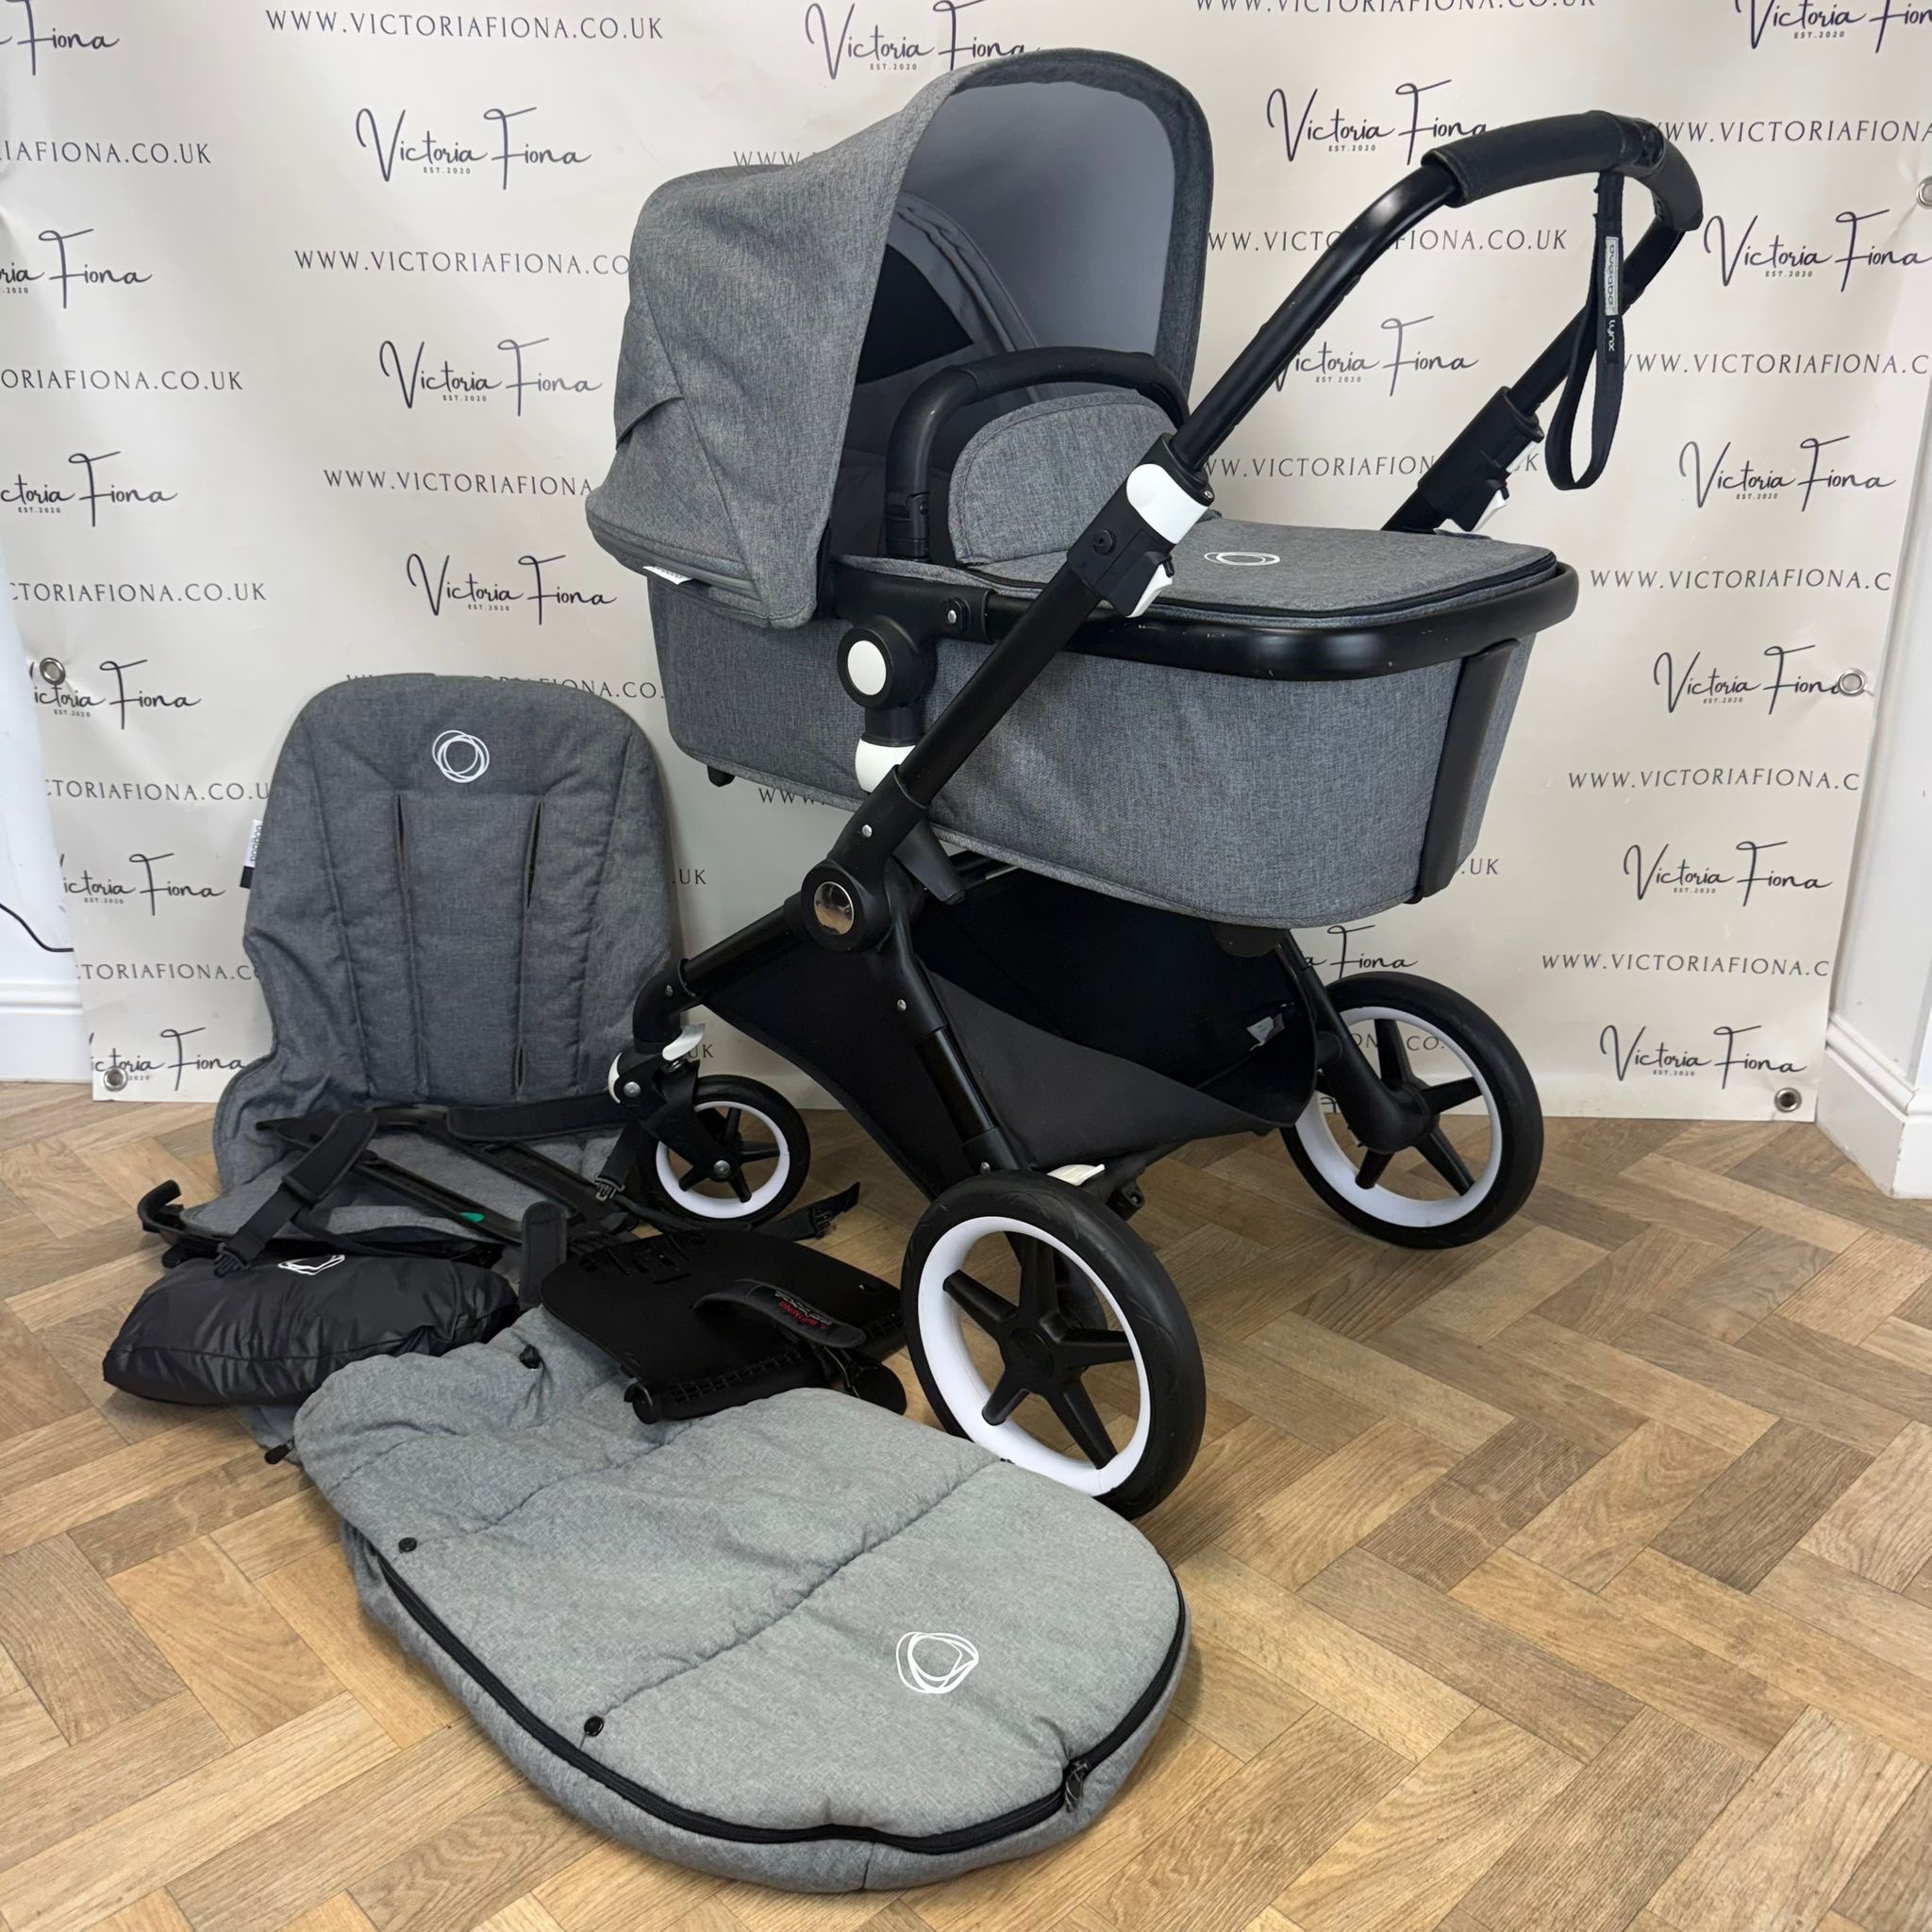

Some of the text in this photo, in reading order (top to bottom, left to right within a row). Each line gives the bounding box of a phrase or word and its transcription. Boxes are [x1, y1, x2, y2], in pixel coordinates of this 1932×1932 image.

[265, 9, 664, 41] WWW.VICTORIAFIONA.CO.UK
[806, 3, 936, 79] Victoria
[0, 141, 211, 164] IAFIONA.CO.UK
[356, 106, 593, 191] Victoria Fiona
[1266, 88, 1396, 163] Victoria
[1328, 144, 1377, 153] EST.2020
[423, 166, 472, 175] EST.2020
[0, 228, 153, 309] ria Fiona
[1703, 208, 1932, 292] Victoria Fiona
[1765, 270, 1814, 278] EST.2020
[378, 337, 604, 417] Victoria Fiona
[1380, 314, 1480, 397] Fiona
[442, 394, 489, 403] EST.2020
[67, 450, 178, 528] Fiona
[1678, 435, 1897, 512] Victoria Fiona
[406, 553, 619, 626] Victoria Fiona
[99, 658, 202, 731] Fiona
[1652, 650, 1760, 713] Victoria
[60, 852, 227, 917] ictoria Fiona
[1622, 840, 1833, 907] Victoria Fiona
[1326, 924, 1420, 980] Fiona
[159, 1026, 247, 1091] Fiona
[1599, 1024, 1808, 1091] Victoria Fiona
